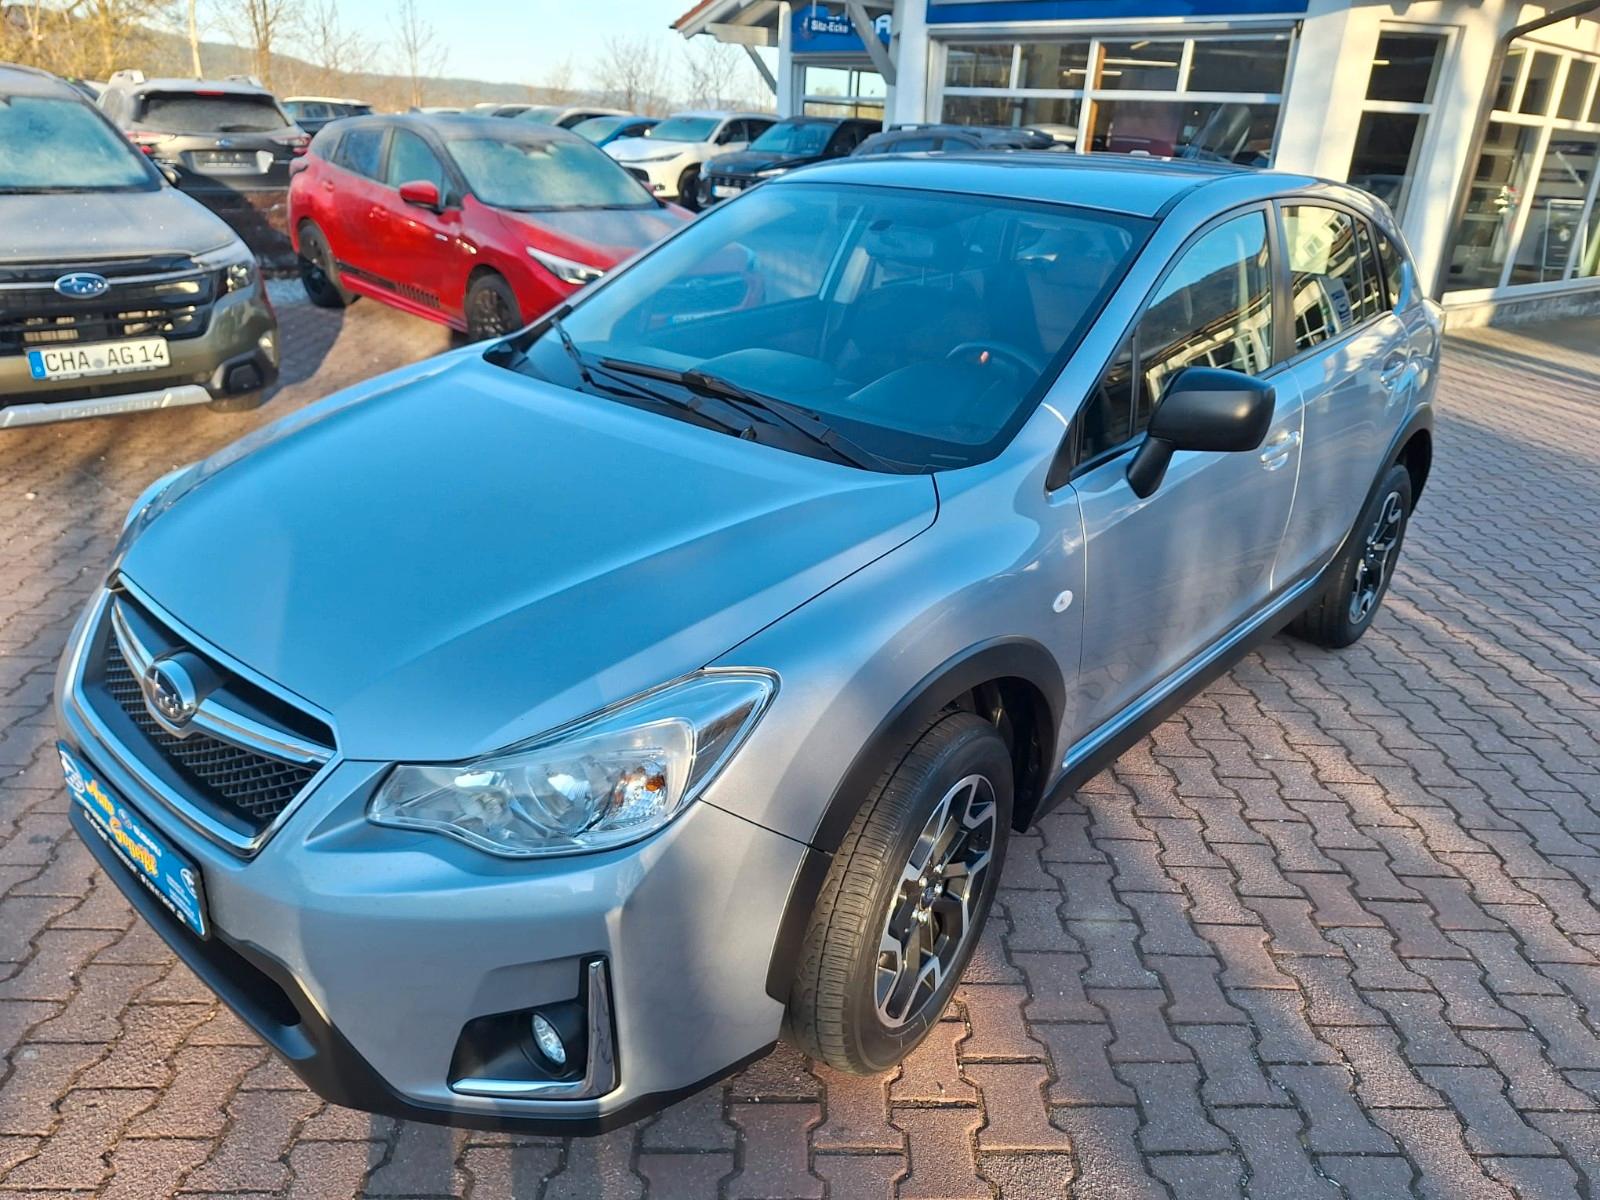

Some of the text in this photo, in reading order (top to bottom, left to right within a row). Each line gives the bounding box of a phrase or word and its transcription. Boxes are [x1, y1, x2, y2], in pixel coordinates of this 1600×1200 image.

[45, 343, 164, 372] CHA AG 14
